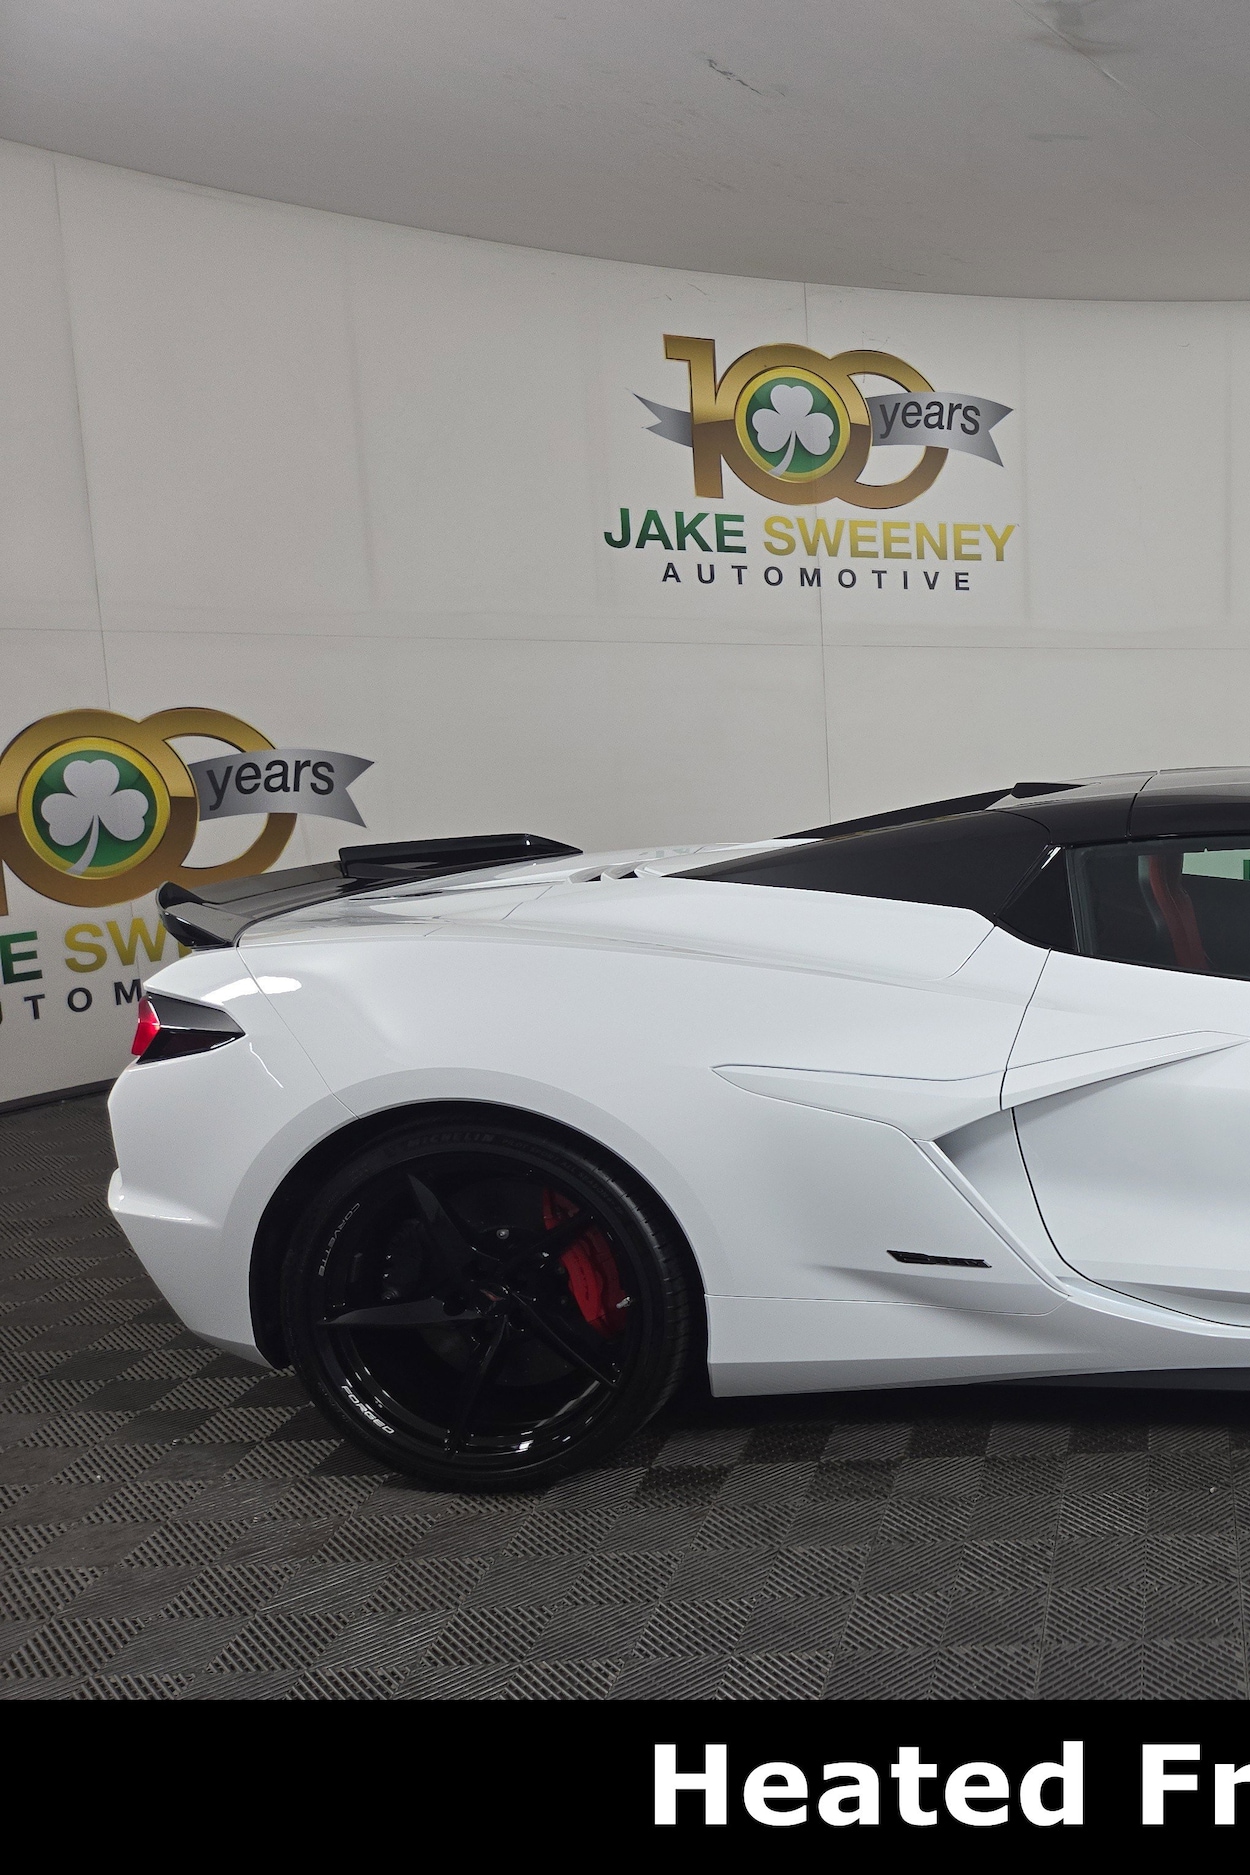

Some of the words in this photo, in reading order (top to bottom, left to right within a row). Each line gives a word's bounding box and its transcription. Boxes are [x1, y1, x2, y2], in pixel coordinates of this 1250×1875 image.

[662, 334, 949, 509] 100
[879, 400, 981, 440] years
[604, 507, 747, 554] JAKE
[764, 516, 1016, 562] SWEENEY
[662, 562, 970, 591] AUTOMOTIVE
[206, 758, 335, 811] years
[407, 1132, 495, 1149] MICHELIN
[318, 1202, 361, 1277] CORVETTE
[341, 1384, 395, 1435] FORGED
